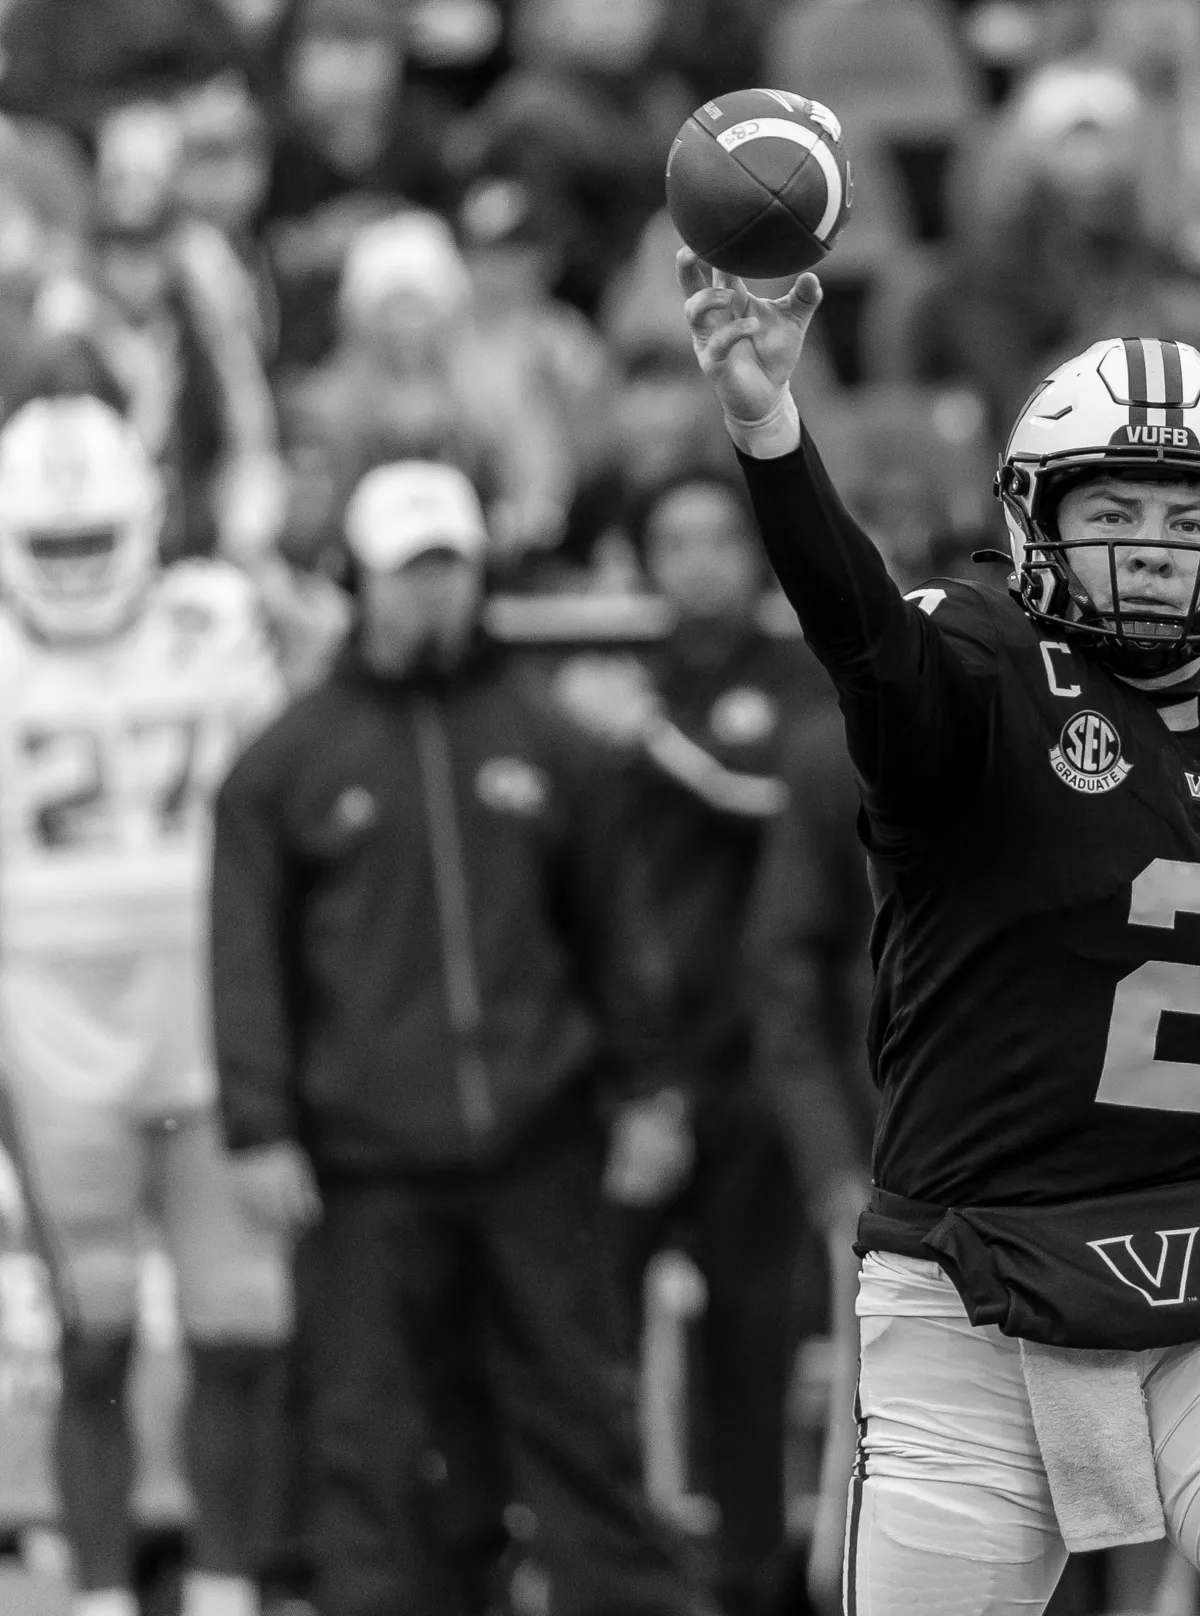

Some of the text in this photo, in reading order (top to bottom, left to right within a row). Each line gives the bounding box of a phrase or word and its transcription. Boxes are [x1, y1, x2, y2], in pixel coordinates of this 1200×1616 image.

[1126, 425, 1189, 447] VUFB
[1039, 640, 1082, 698] C
[1066, 714, 1116, 772] SEC
[18, 708, 204, 853] 27
[1055, 761, 1121, 791] GRADUATE
[1085, 1226, 1200, 1307] V
